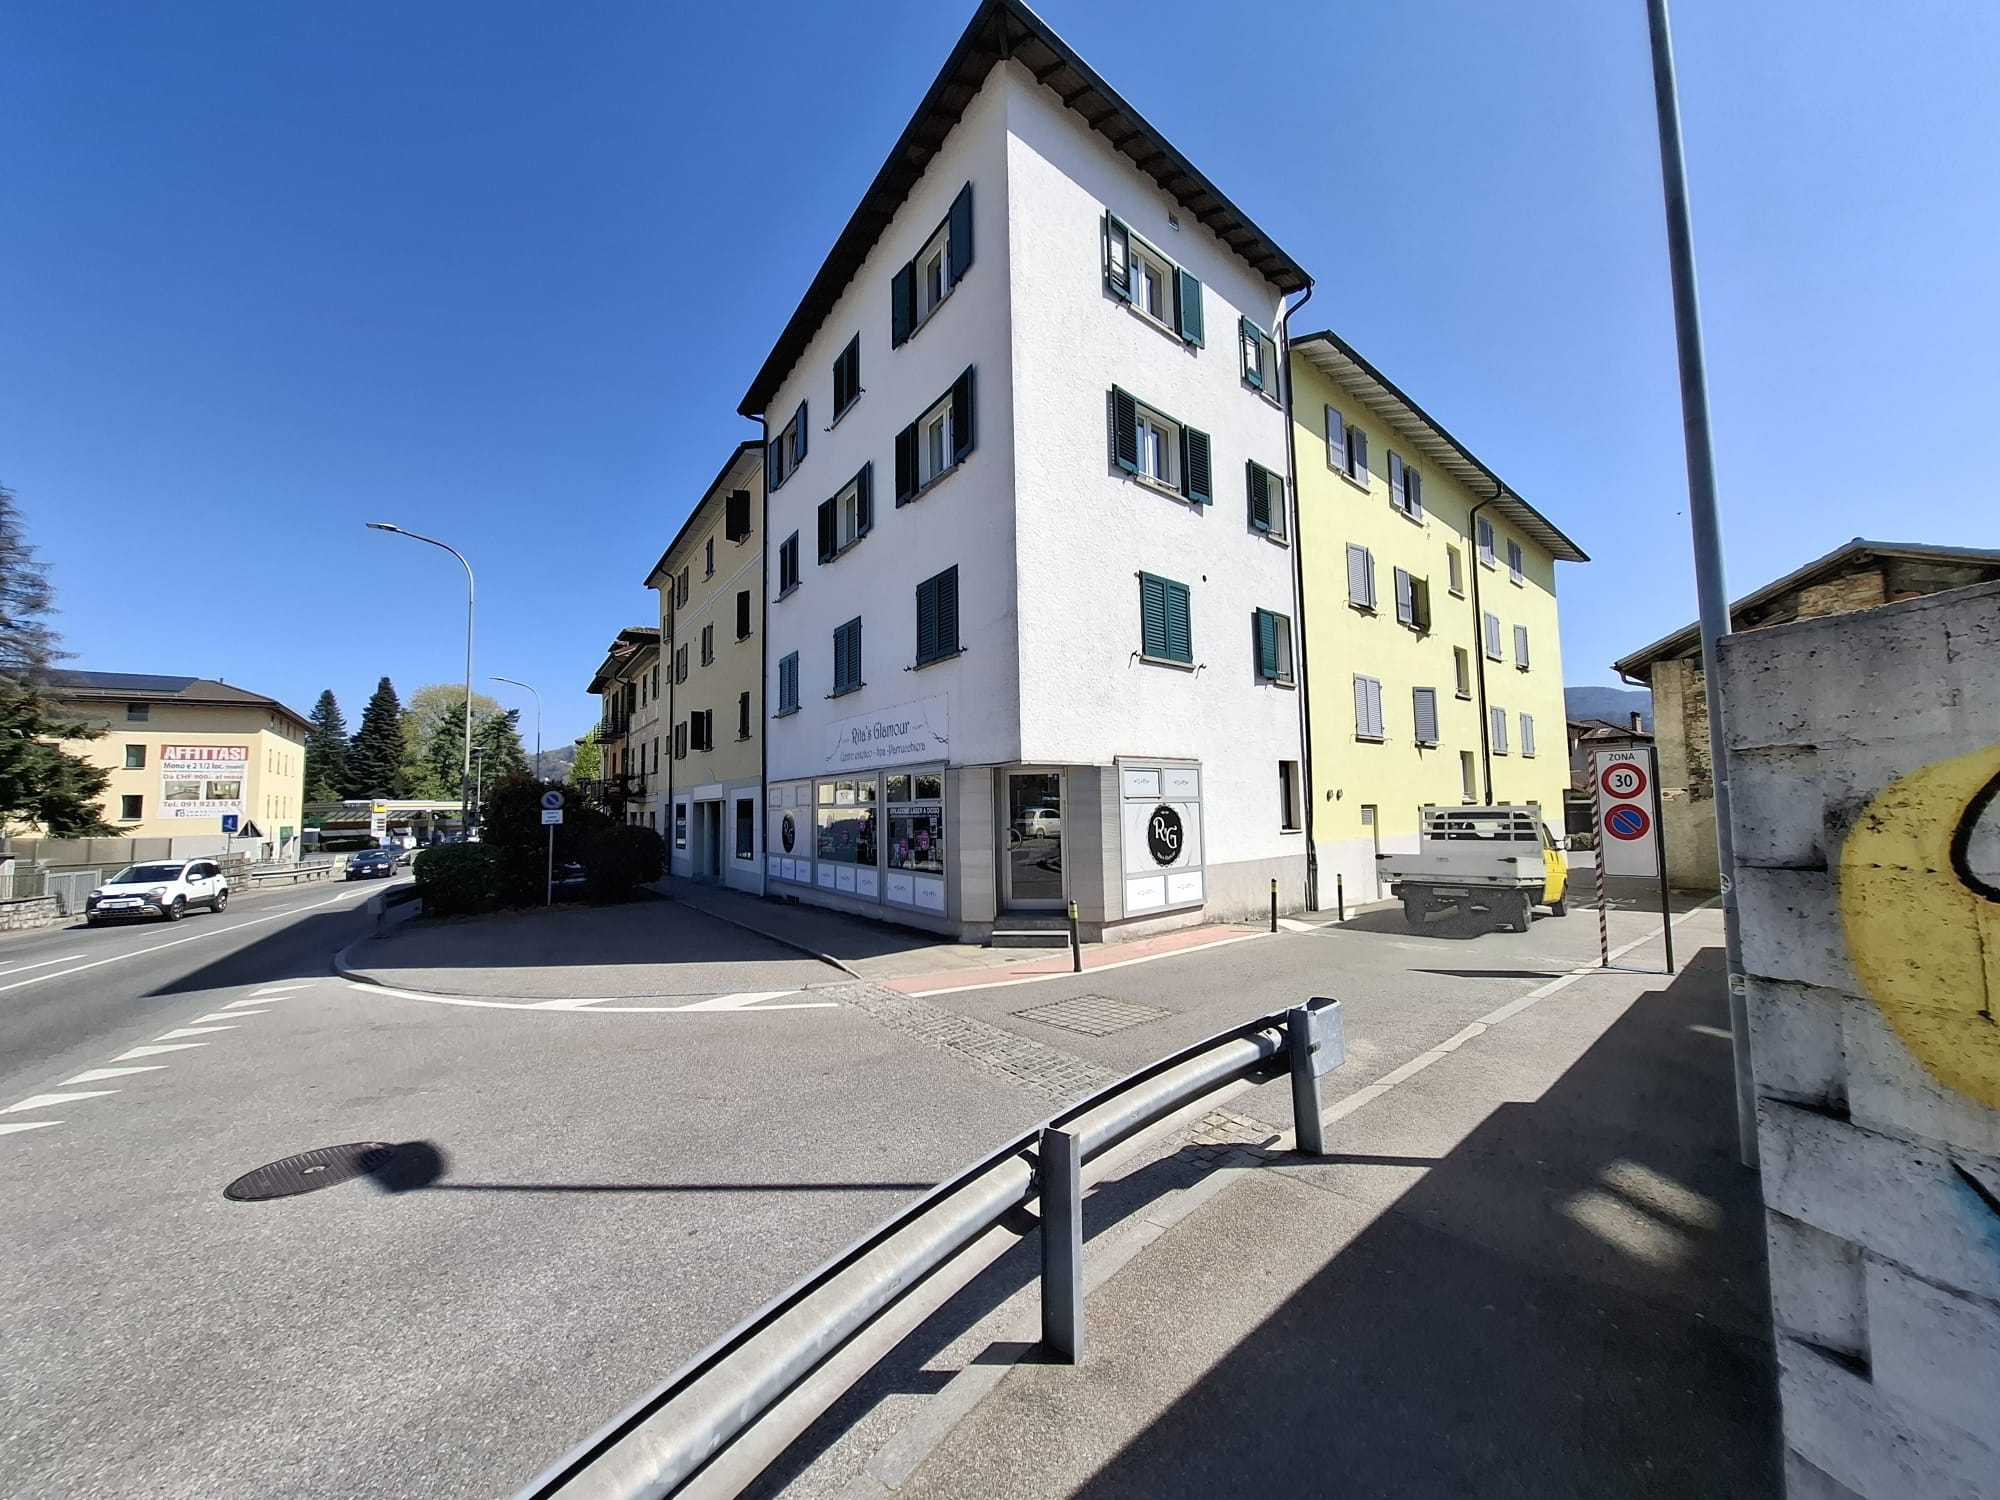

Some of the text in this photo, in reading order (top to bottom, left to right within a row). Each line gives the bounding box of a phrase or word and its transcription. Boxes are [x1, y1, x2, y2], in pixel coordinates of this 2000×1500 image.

[873, 721, 910, 740] Glamour
[163, 746, 246, 760] AFFITTASI
[1608, 752, 1635, 761] ZONA
[199, 762, 210, 770] 1/2
[1615, 774, 1633, 788] 30
